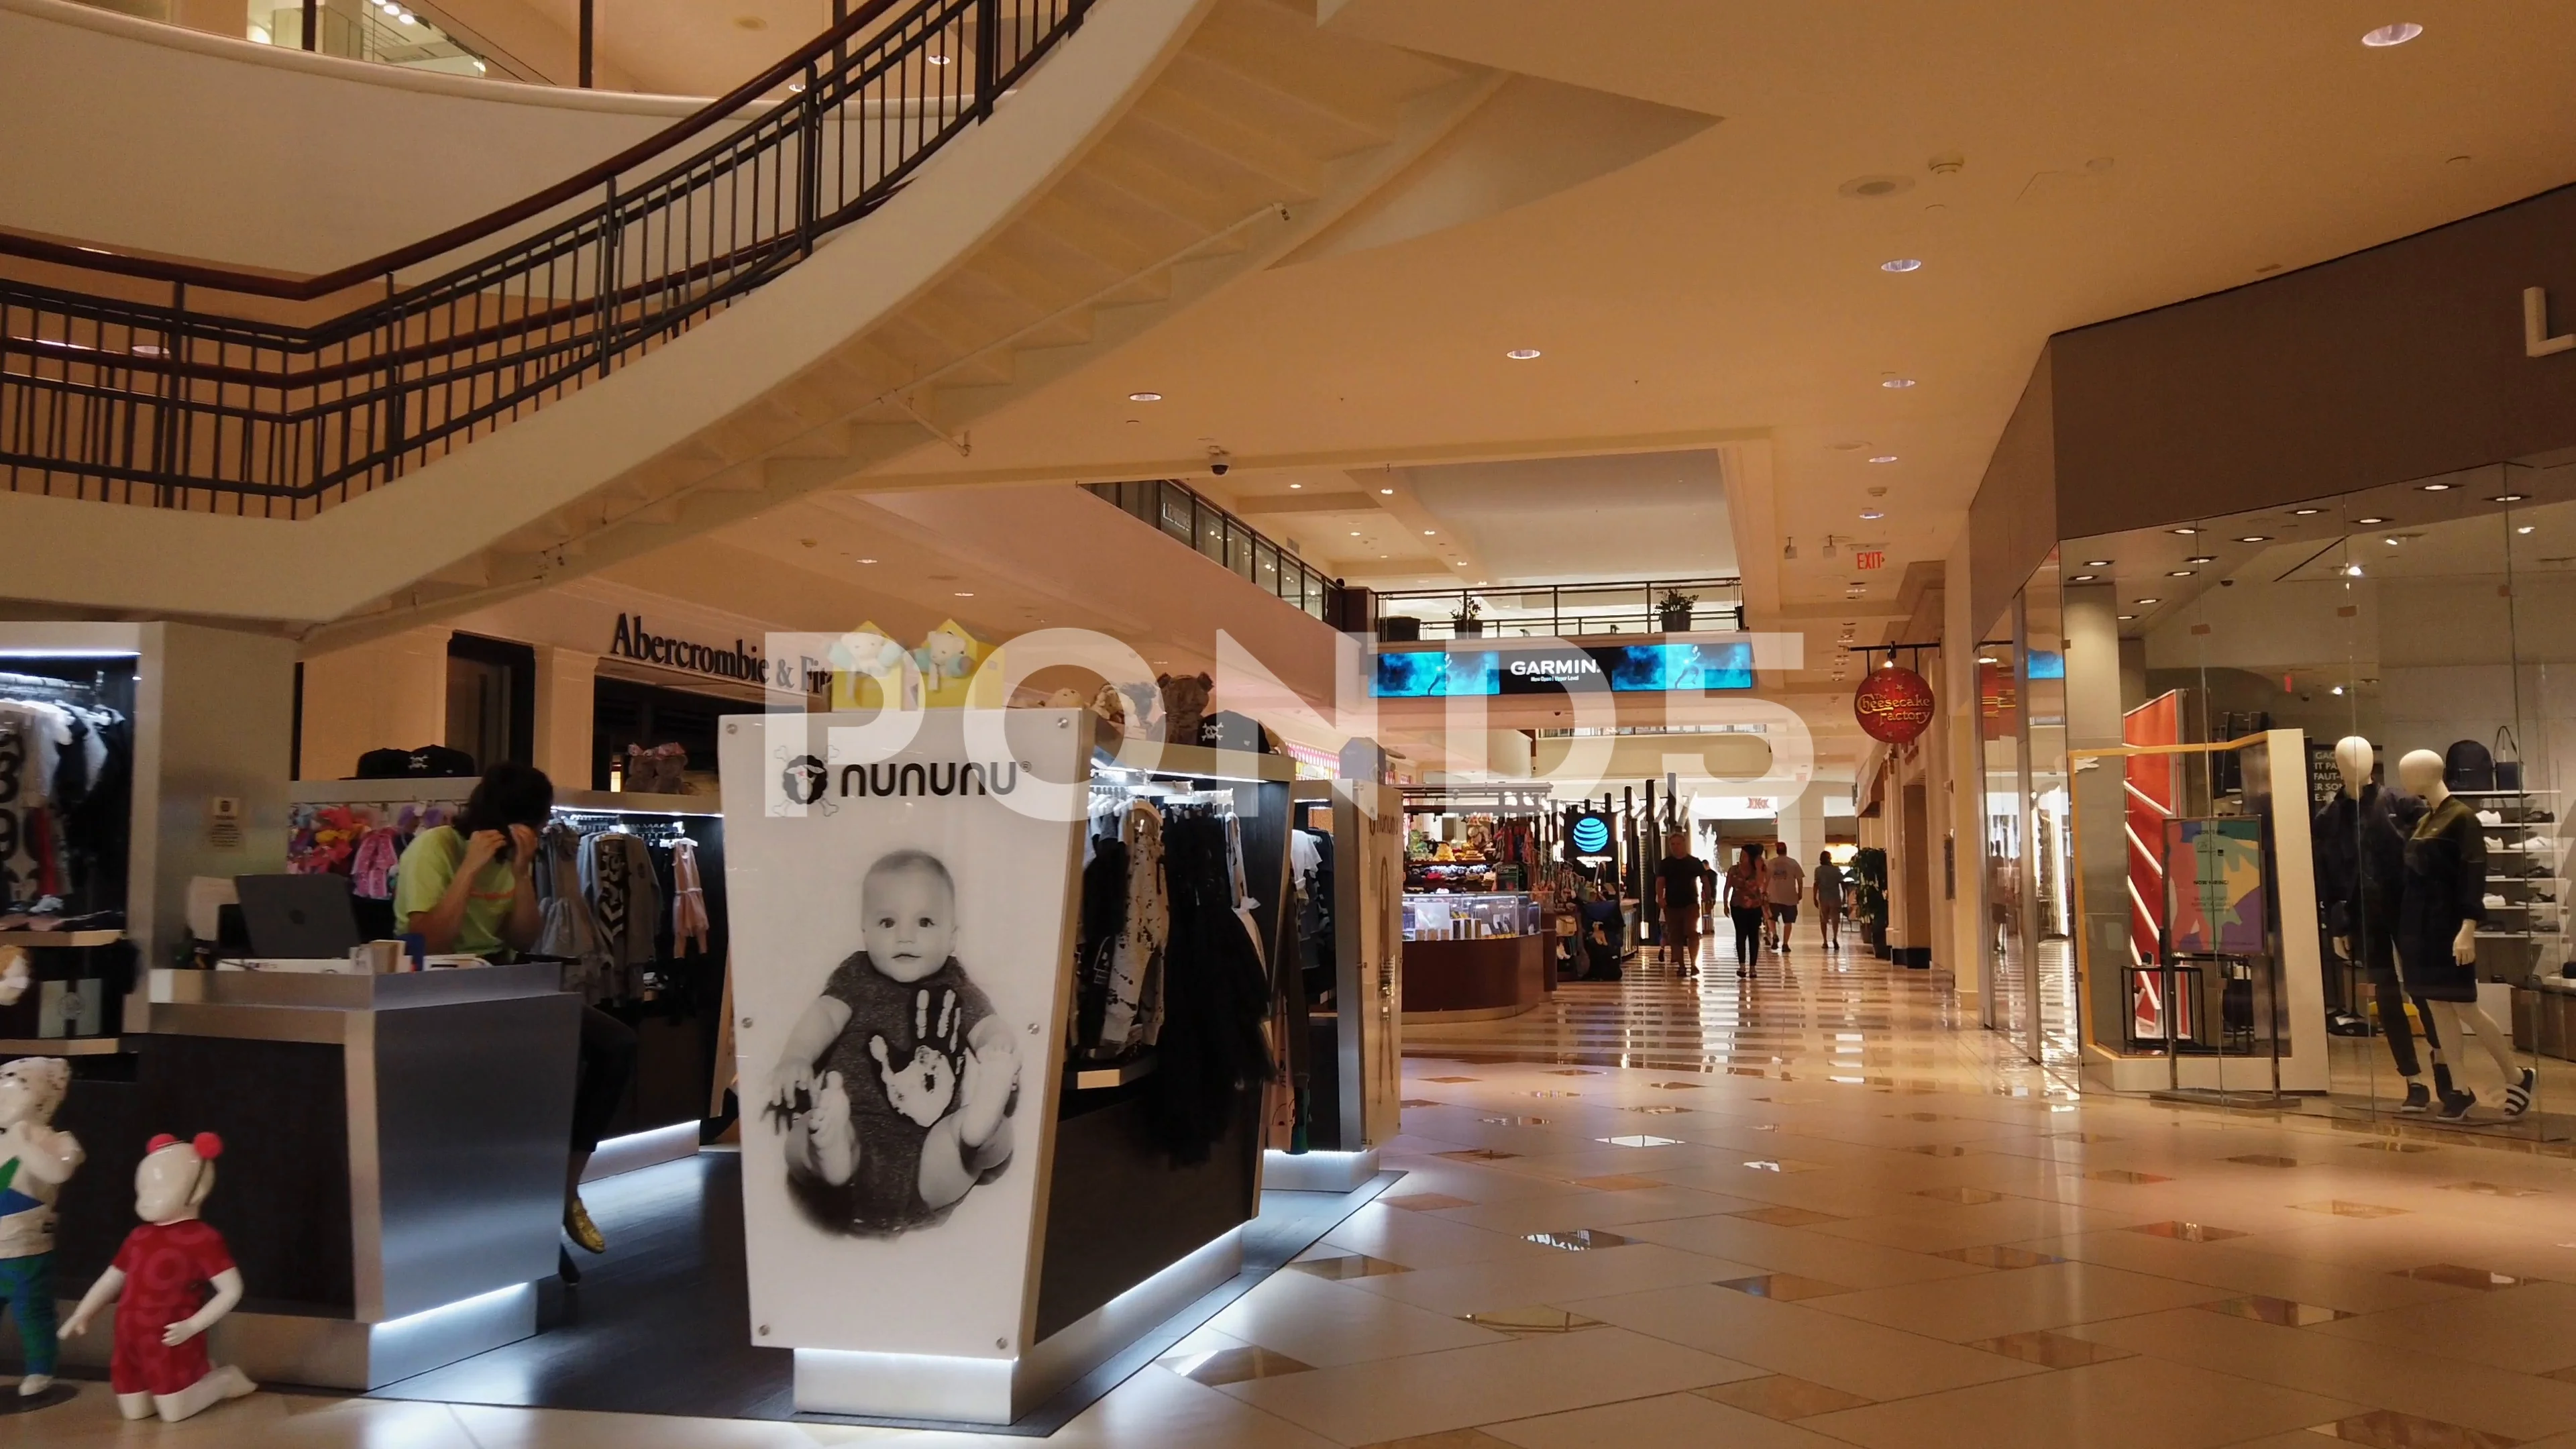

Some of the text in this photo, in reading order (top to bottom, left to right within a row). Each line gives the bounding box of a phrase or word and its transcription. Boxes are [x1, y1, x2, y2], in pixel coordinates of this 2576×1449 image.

[1857, 551, 1882, 570] EXIT
[610, 612, 770, 684] Abercrombie
[776, 658, 795, 689] &
[1856, 694, 1932, 714] Cheesecake
[1878, 710, 1931, 727] Factory
